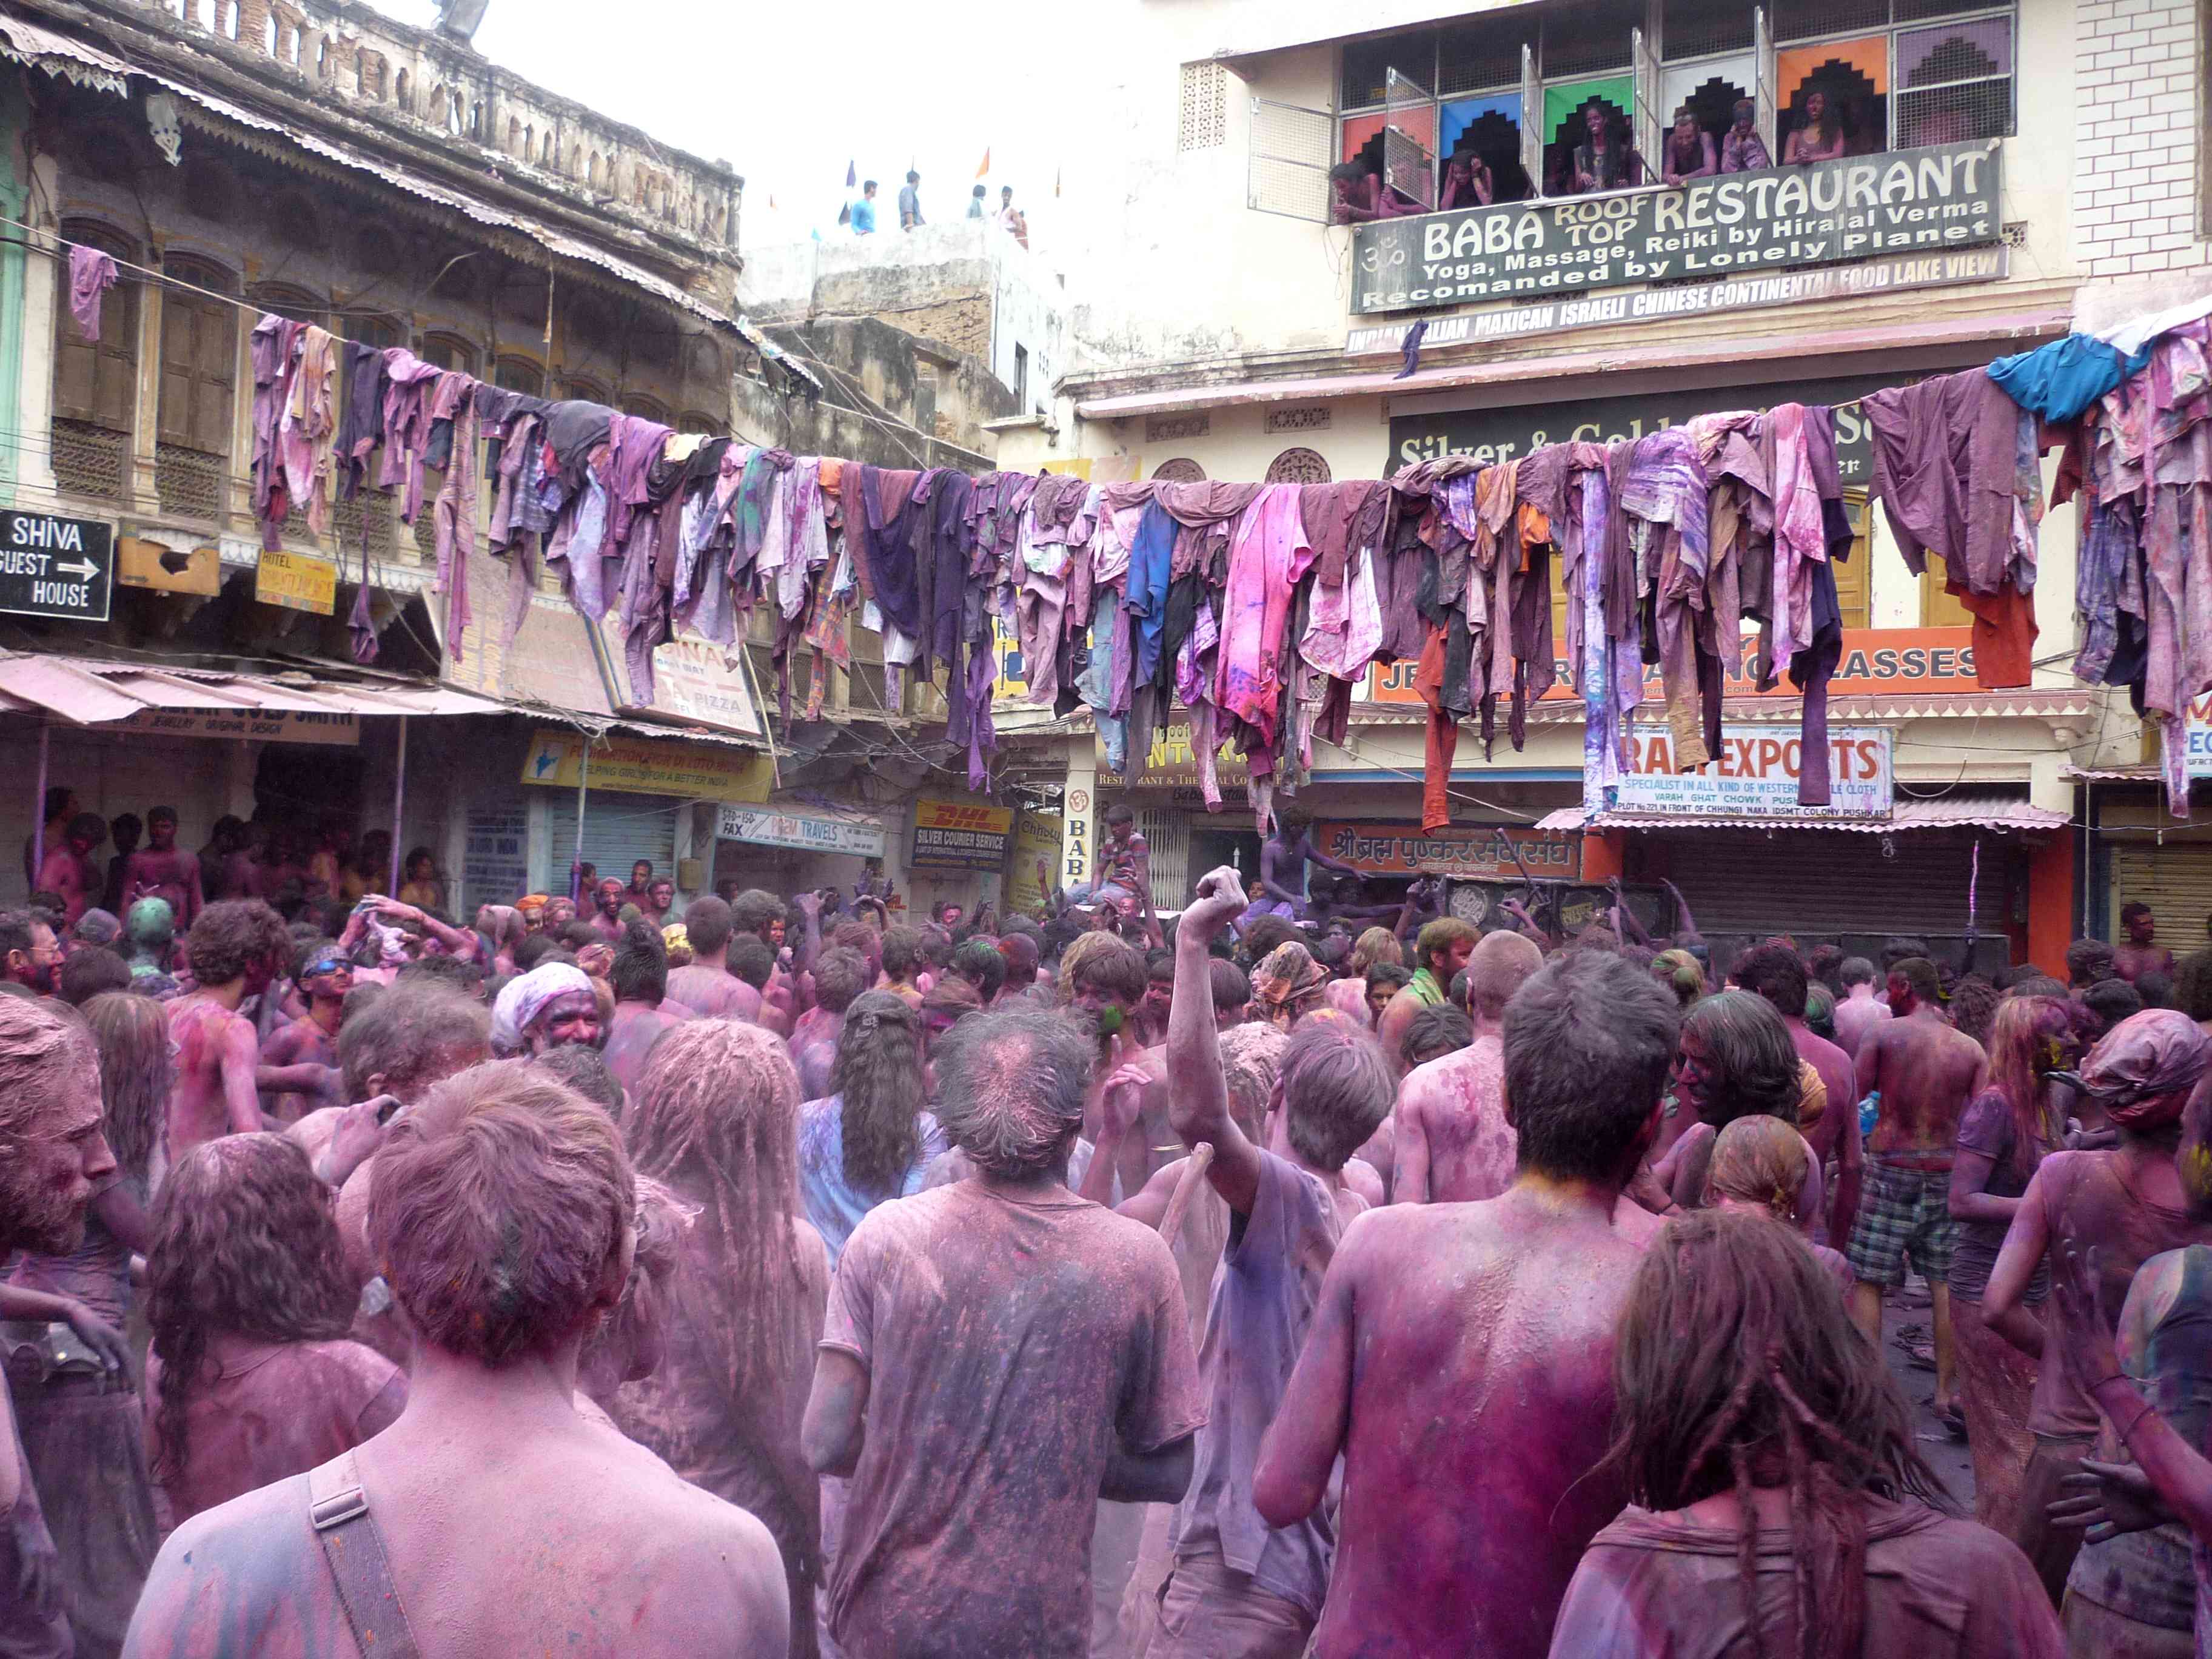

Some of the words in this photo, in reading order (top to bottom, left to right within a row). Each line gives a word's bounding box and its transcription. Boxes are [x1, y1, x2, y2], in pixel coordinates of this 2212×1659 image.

[1424, 212, 1544, 261] BABA
[1555, 194, 1651, 226] ROOF
[1655, 151, 1989, 232] RESTAURANT
[1423, 260, 1495, 280] Yoga,
[1505, 245, 1634, 272] Massage,
[1646, 229, 1717, 253] Reiki
[1729, 227, 1763, 249] by
[1772, 209, 1875, 239] Hiralal
[1886, 199, 1988, 225] Verma
[1565, 218, 1638, 246] TOP
[1362, 265, 1609, 307] Recomanded
[1624, 260, 1670, 278] by
[1686, 240, 1826, 270] Lonely
[1843, 219, 1989, 250] Planet
[1475, 310, 1555, 337] MAXICAN
[1560, 304, 1626, 327] ISRAELI
[1632, 288, 1707, 315] CHINESE
[1711, 273, 1835, 308] CONTINENTAL
[1838, 264, 1889, 289] FOOD
[1894, 258, 1941, 285] LAKE
[1945, 252, 1999, 280] VIEW
[1400, 435, 1515, 464] Silver
[33, 580, 90, 606] HOUSE
[694, 692, 741, 712] PIZZA
[1717, 737, 1878, 780] EXPOTS
[1624, 779, 1680, 791] SPECIALIST
[1683, 780, 1694, 791] IN
[1697, 781, 1714, 791] ALL
[1717, 782, 1739, 793] KIND
[1744, 783, 1755, 793] OF
[1847, 785, 1877, 796] CLOTH
[1654, 793, 1683, 802] VARAH
[1691, 794, 1718, 803] GHAT
[1723, 795, 1763, 804] CHOWK
[934, 805, 991, 829] DHL
[1617, 802, 1634, 811] PLOT
[1668, 803, 1692, 813] FRONT
[1694, 805, 1704, 813] OF
[1706, 804, 1742, 814] CHHUNGI
[1772, 807, 1800, 816] IDSMT
[1803, 808, 1840, 816] COLONY
[1843, 809, 1886, 817] PUSHKAR
[722, 822, 743, 836] FAX
[801, 820, 837, 842] TRAVELS
[917, 828, 943, 845] SILVER
[943, 831, 975, 848] COURIER
[975, 833, 1005, 850] SERVICE
[1330, 826, 1356, 860] श्री
